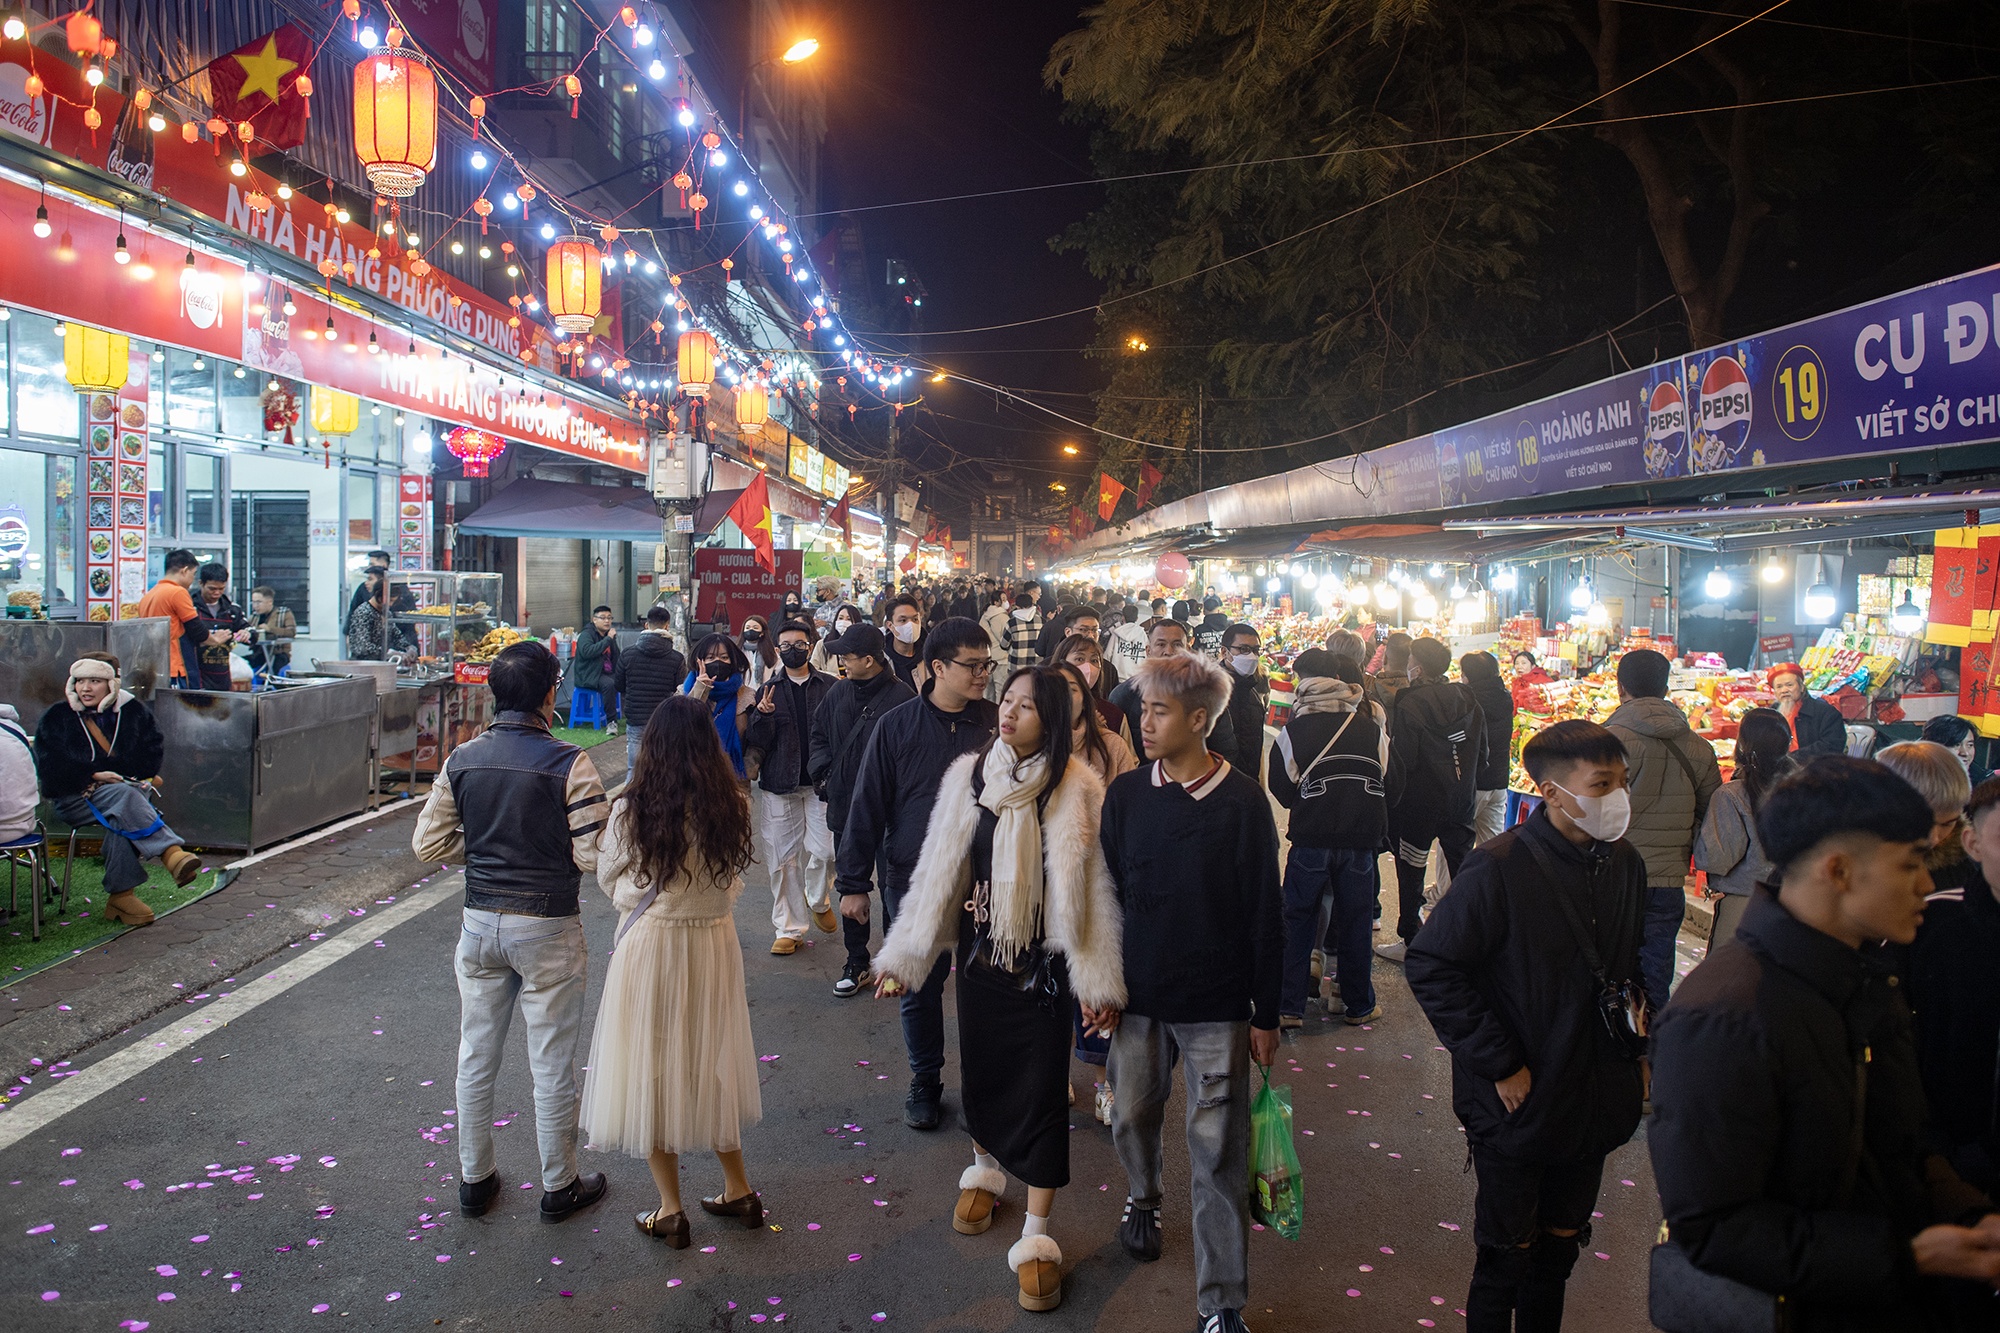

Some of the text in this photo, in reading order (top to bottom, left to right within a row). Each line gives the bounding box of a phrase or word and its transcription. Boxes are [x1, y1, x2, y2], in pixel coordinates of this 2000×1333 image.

[225, 183, 520, 357] NHÀ HÀNG PHƯƠNG DUNG
[1854, 311, 1926, 390] CỤ
[1702, 392, 1750, 421] PEPSI
[1779, 361, 1820, 424] 19
[501, 392, 568, 443] PHƯƠNG
[570, 415, 607, 454] DUNG
[1541, 400, 1632, 446] HOÀNG ANH
[1650, 410, 1685, 433] PEPSI
[1855, 399, 1908, 441] VIẾT
[1914, 394, 1950, 433] SỚ
[1464, 449, 1484, 478] 18A
[1484, 440, 1500, 459] VIẾT
[1516, 435, 1539, 468] 18B
[1485, 465, 1518, 483] CHỮ NHO
[1599, 461, 1612, 473] NHO
[719, 553, 754, 567] HƯƠNG
[700, 570, 721, 584] TÔM
[731, 572, 751, 585] CUA
[785, 569, 799, 586] ỐC
[461, 664, 489, 676] Coca-Cola
